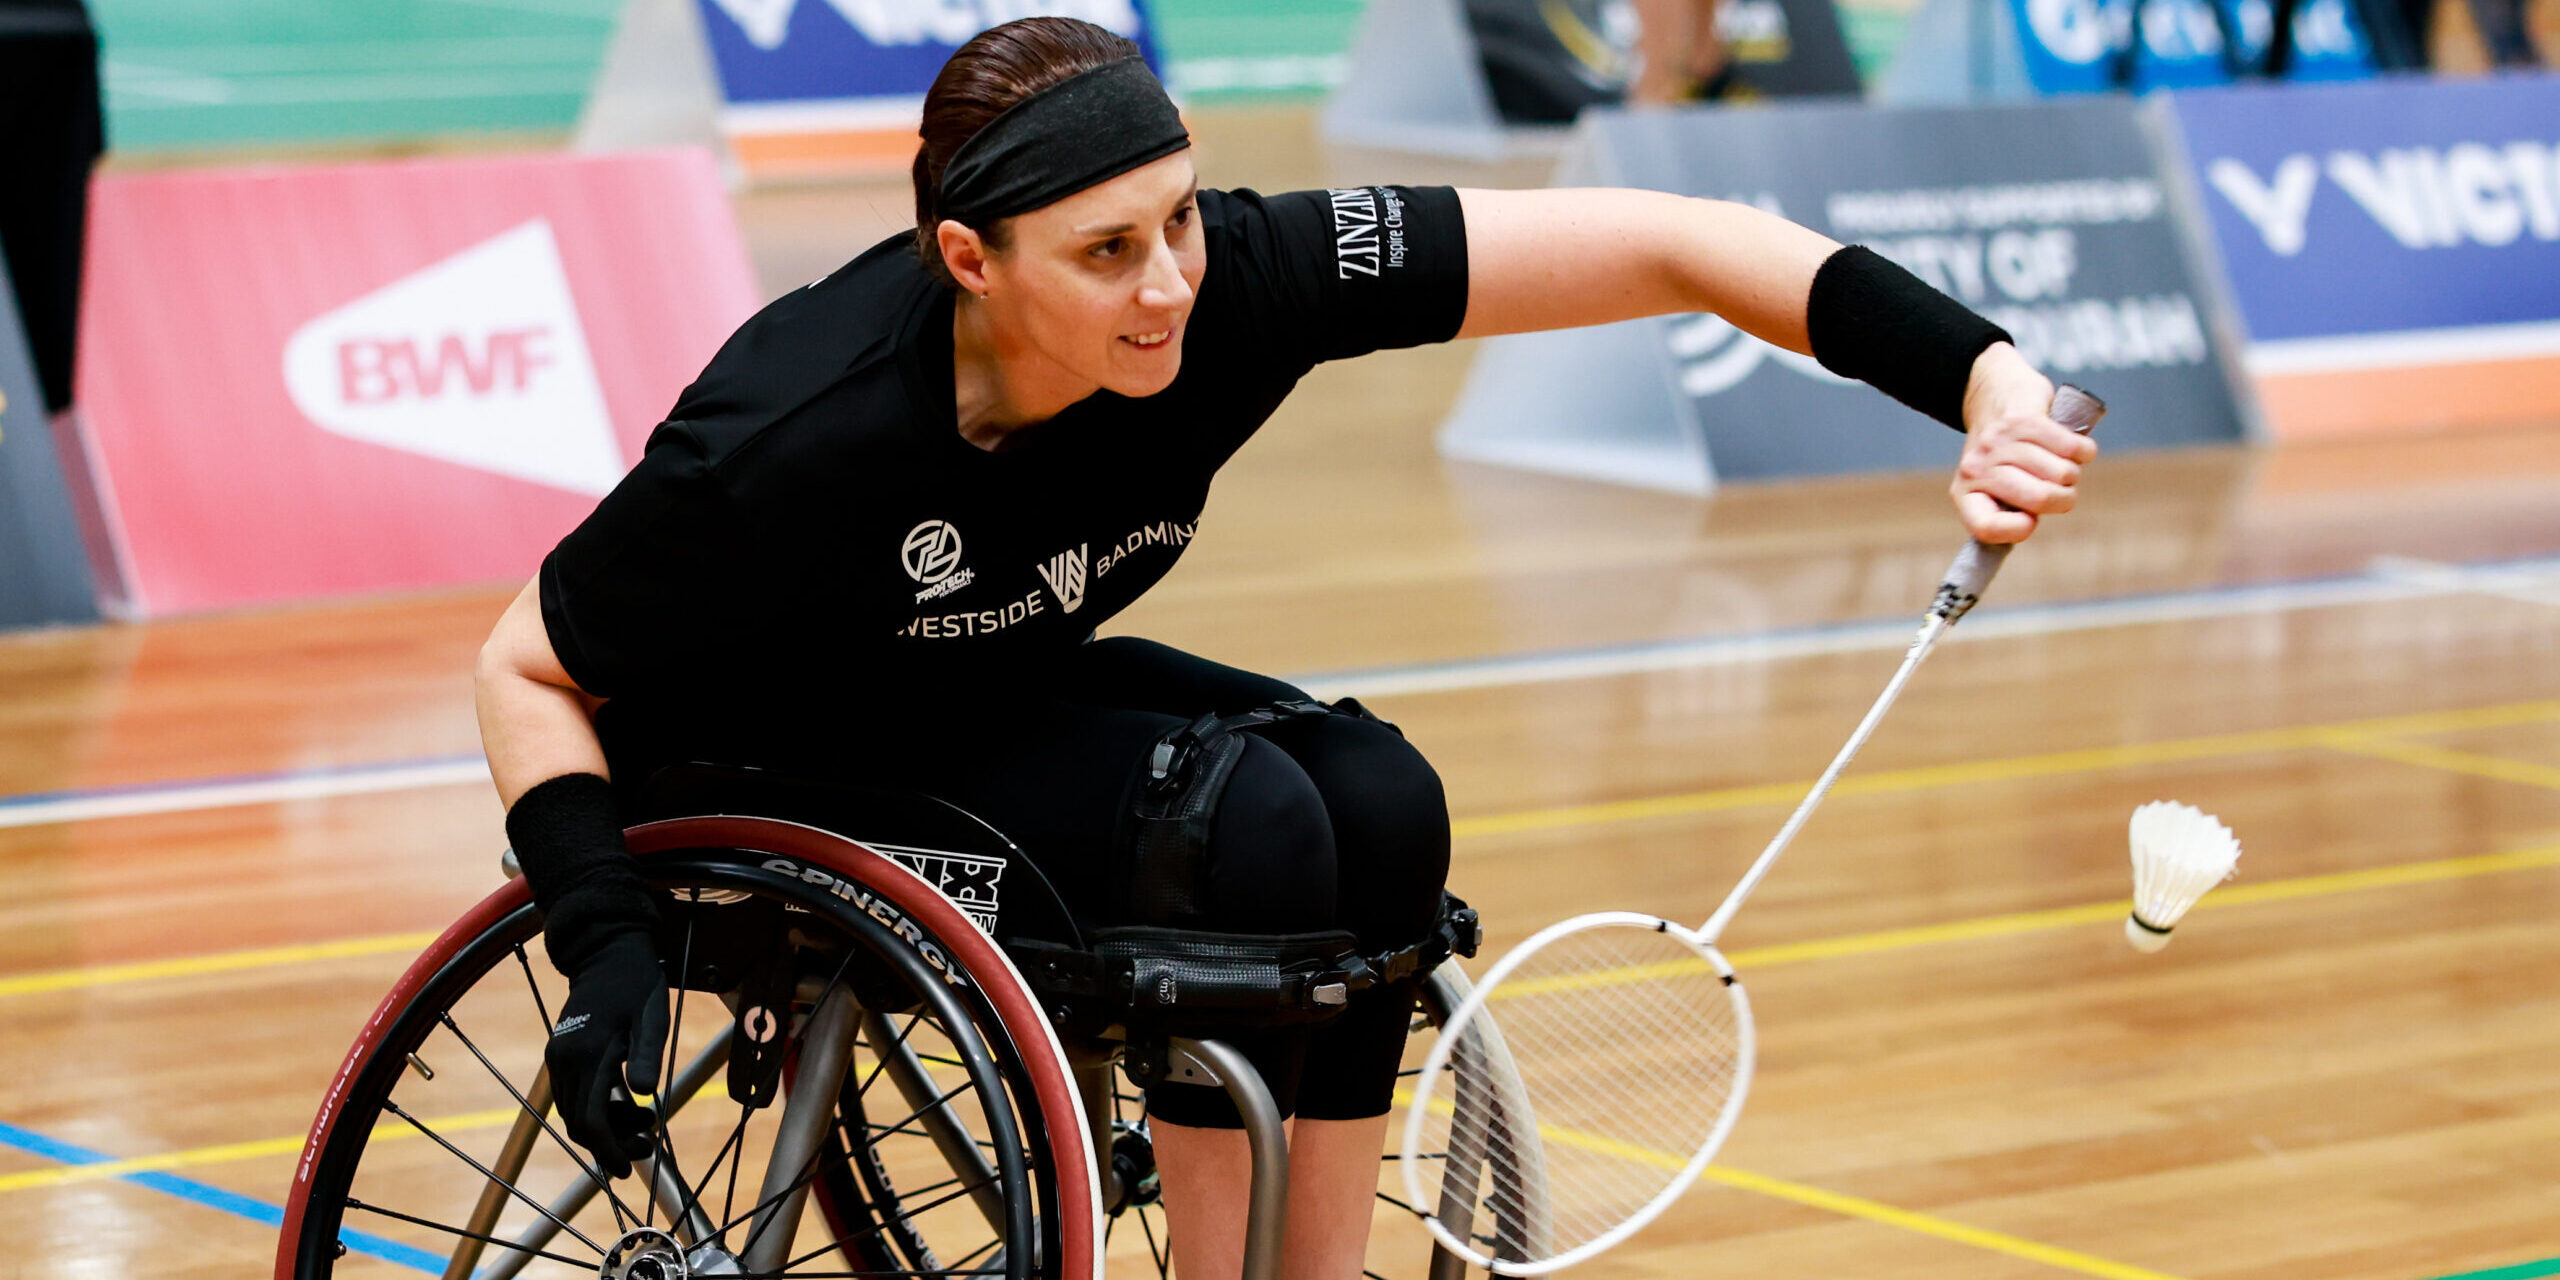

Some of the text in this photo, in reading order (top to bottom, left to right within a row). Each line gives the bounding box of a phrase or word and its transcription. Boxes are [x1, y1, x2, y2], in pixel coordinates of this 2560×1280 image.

[1383, 198, 1405, 228] Change
[1386, 229, 1408, 267] Inspire
[1986, 229, 2079, 301] OF
[337, 327, 556, 403] BWF
[1984, 296, 2206, 372] DURAH
[1096, 514, 1201, 579] BADMIN
